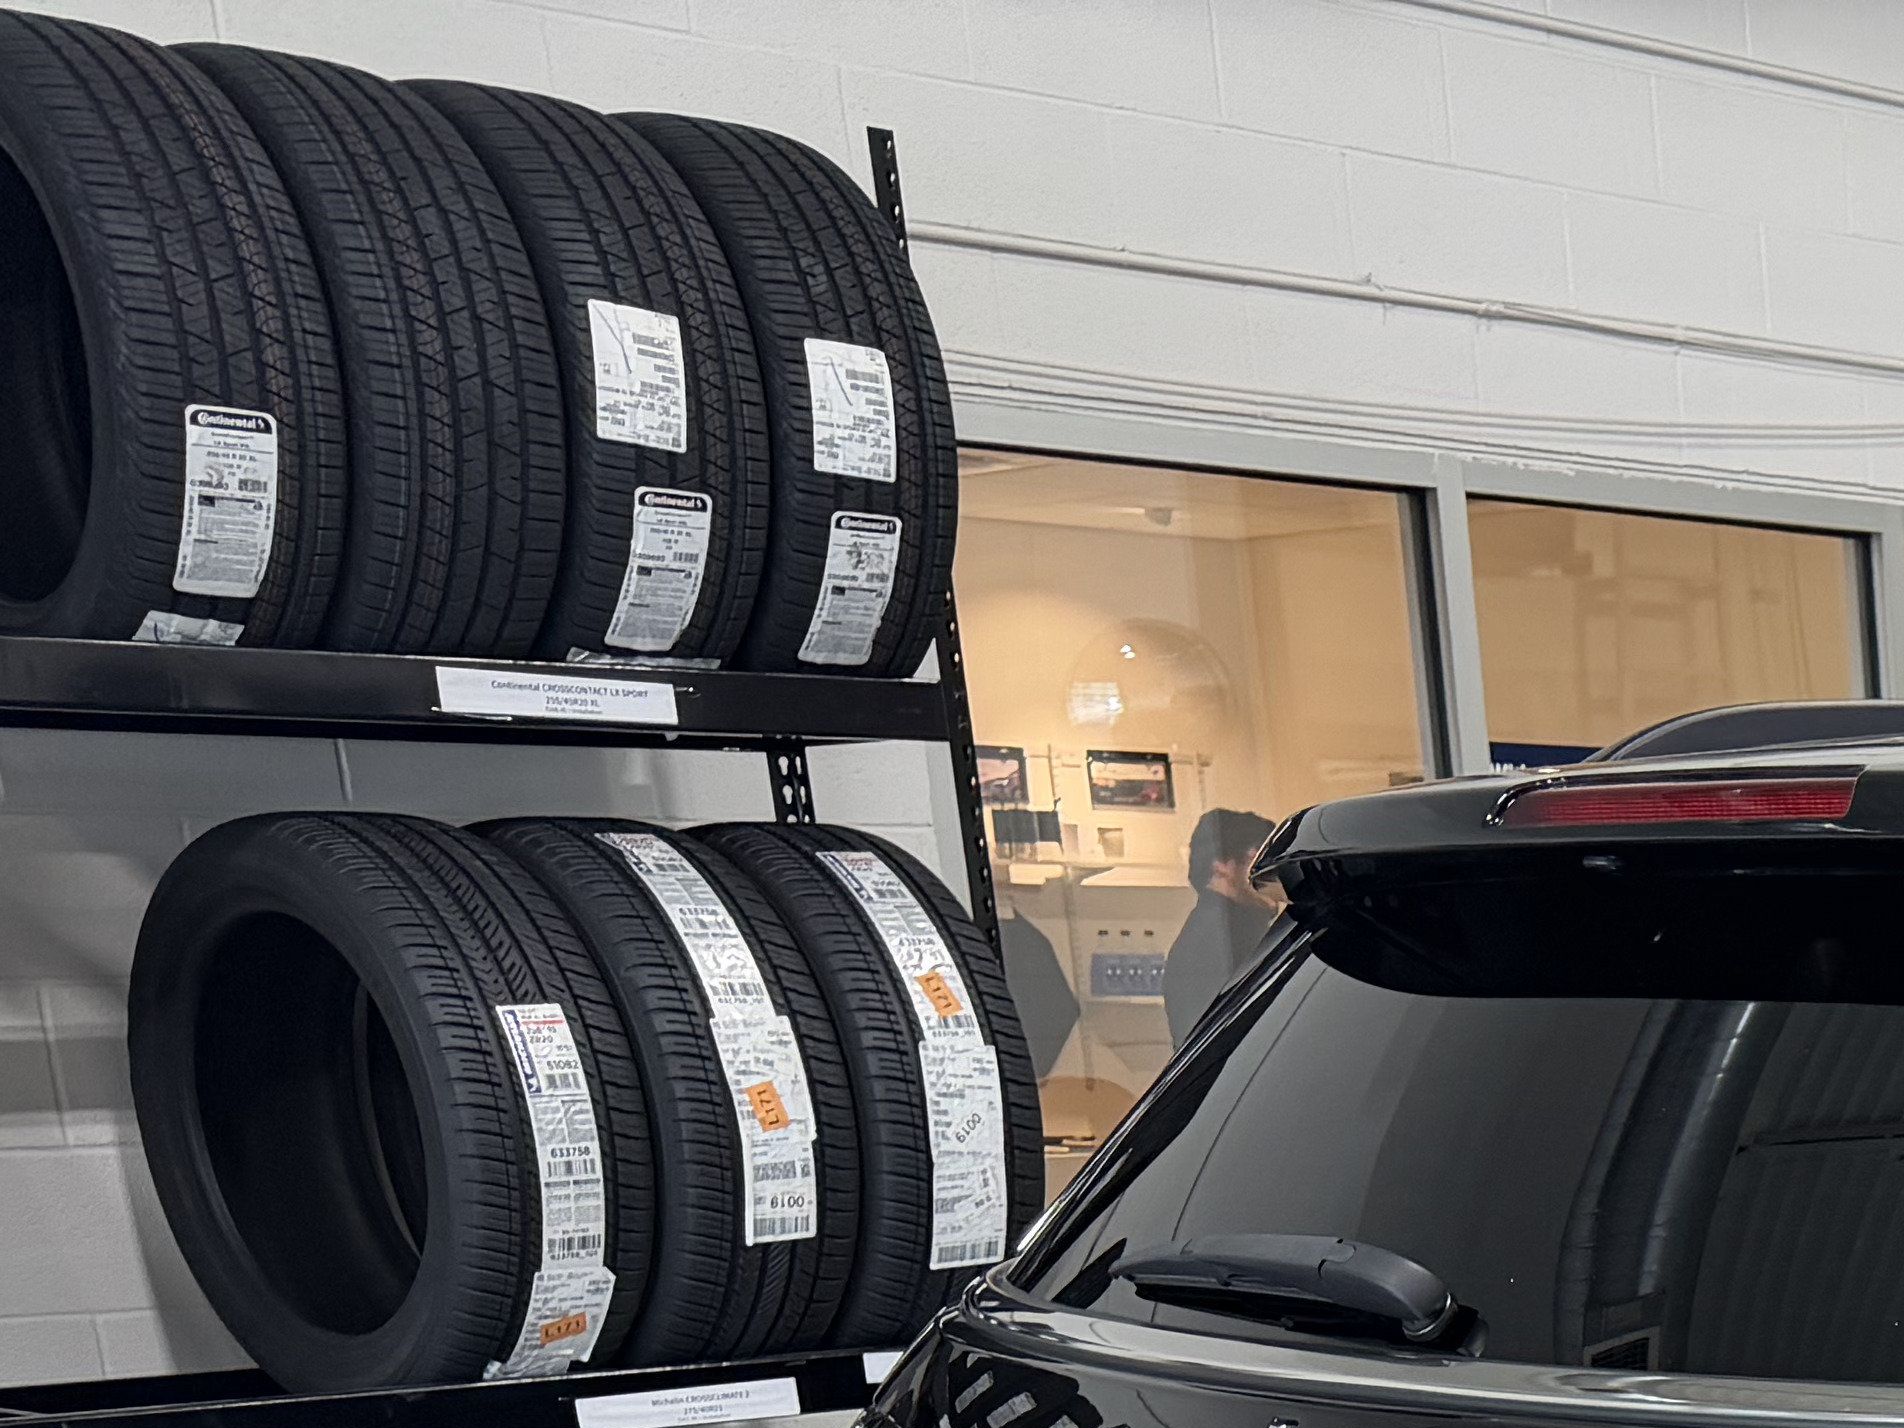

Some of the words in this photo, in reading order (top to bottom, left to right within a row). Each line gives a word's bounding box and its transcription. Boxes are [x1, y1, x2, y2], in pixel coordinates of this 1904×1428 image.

[491, 680, 539, 692] Continental
[621, 690, 648, 698] SPORT
[550, 1146, 590, 1158] 633758
